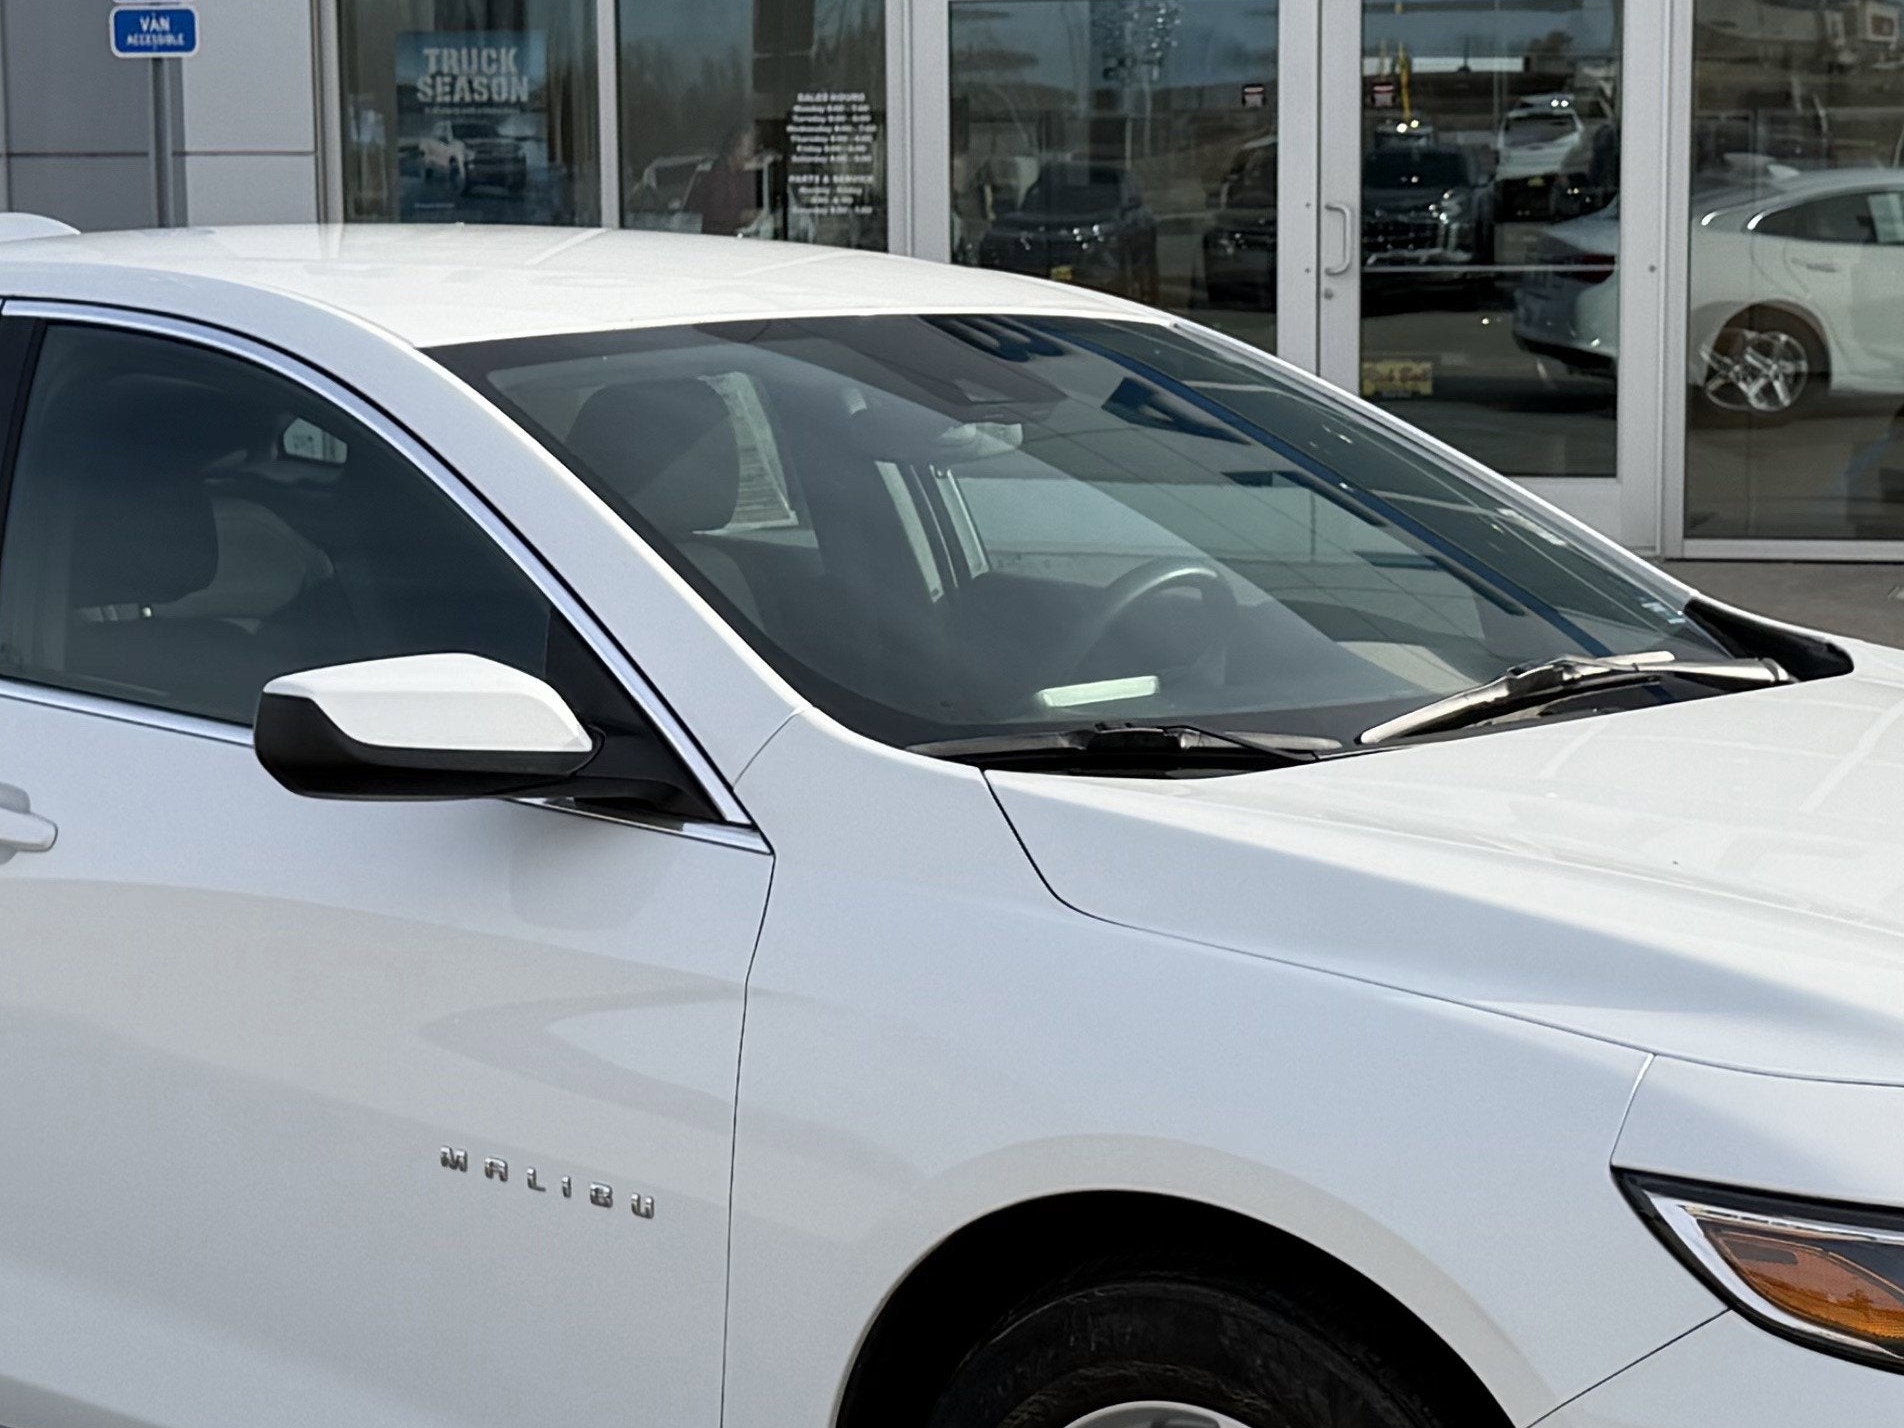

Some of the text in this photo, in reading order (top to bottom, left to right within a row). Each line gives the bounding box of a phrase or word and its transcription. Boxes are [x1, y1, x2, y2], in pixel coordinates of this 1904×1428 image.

[139, 16, 170, 32] VAN
[422, 47, 519, 75] TRUCK
[416, 76, 530, 104] SEASON
[439, 1144, 656, 1220] MALIBU
